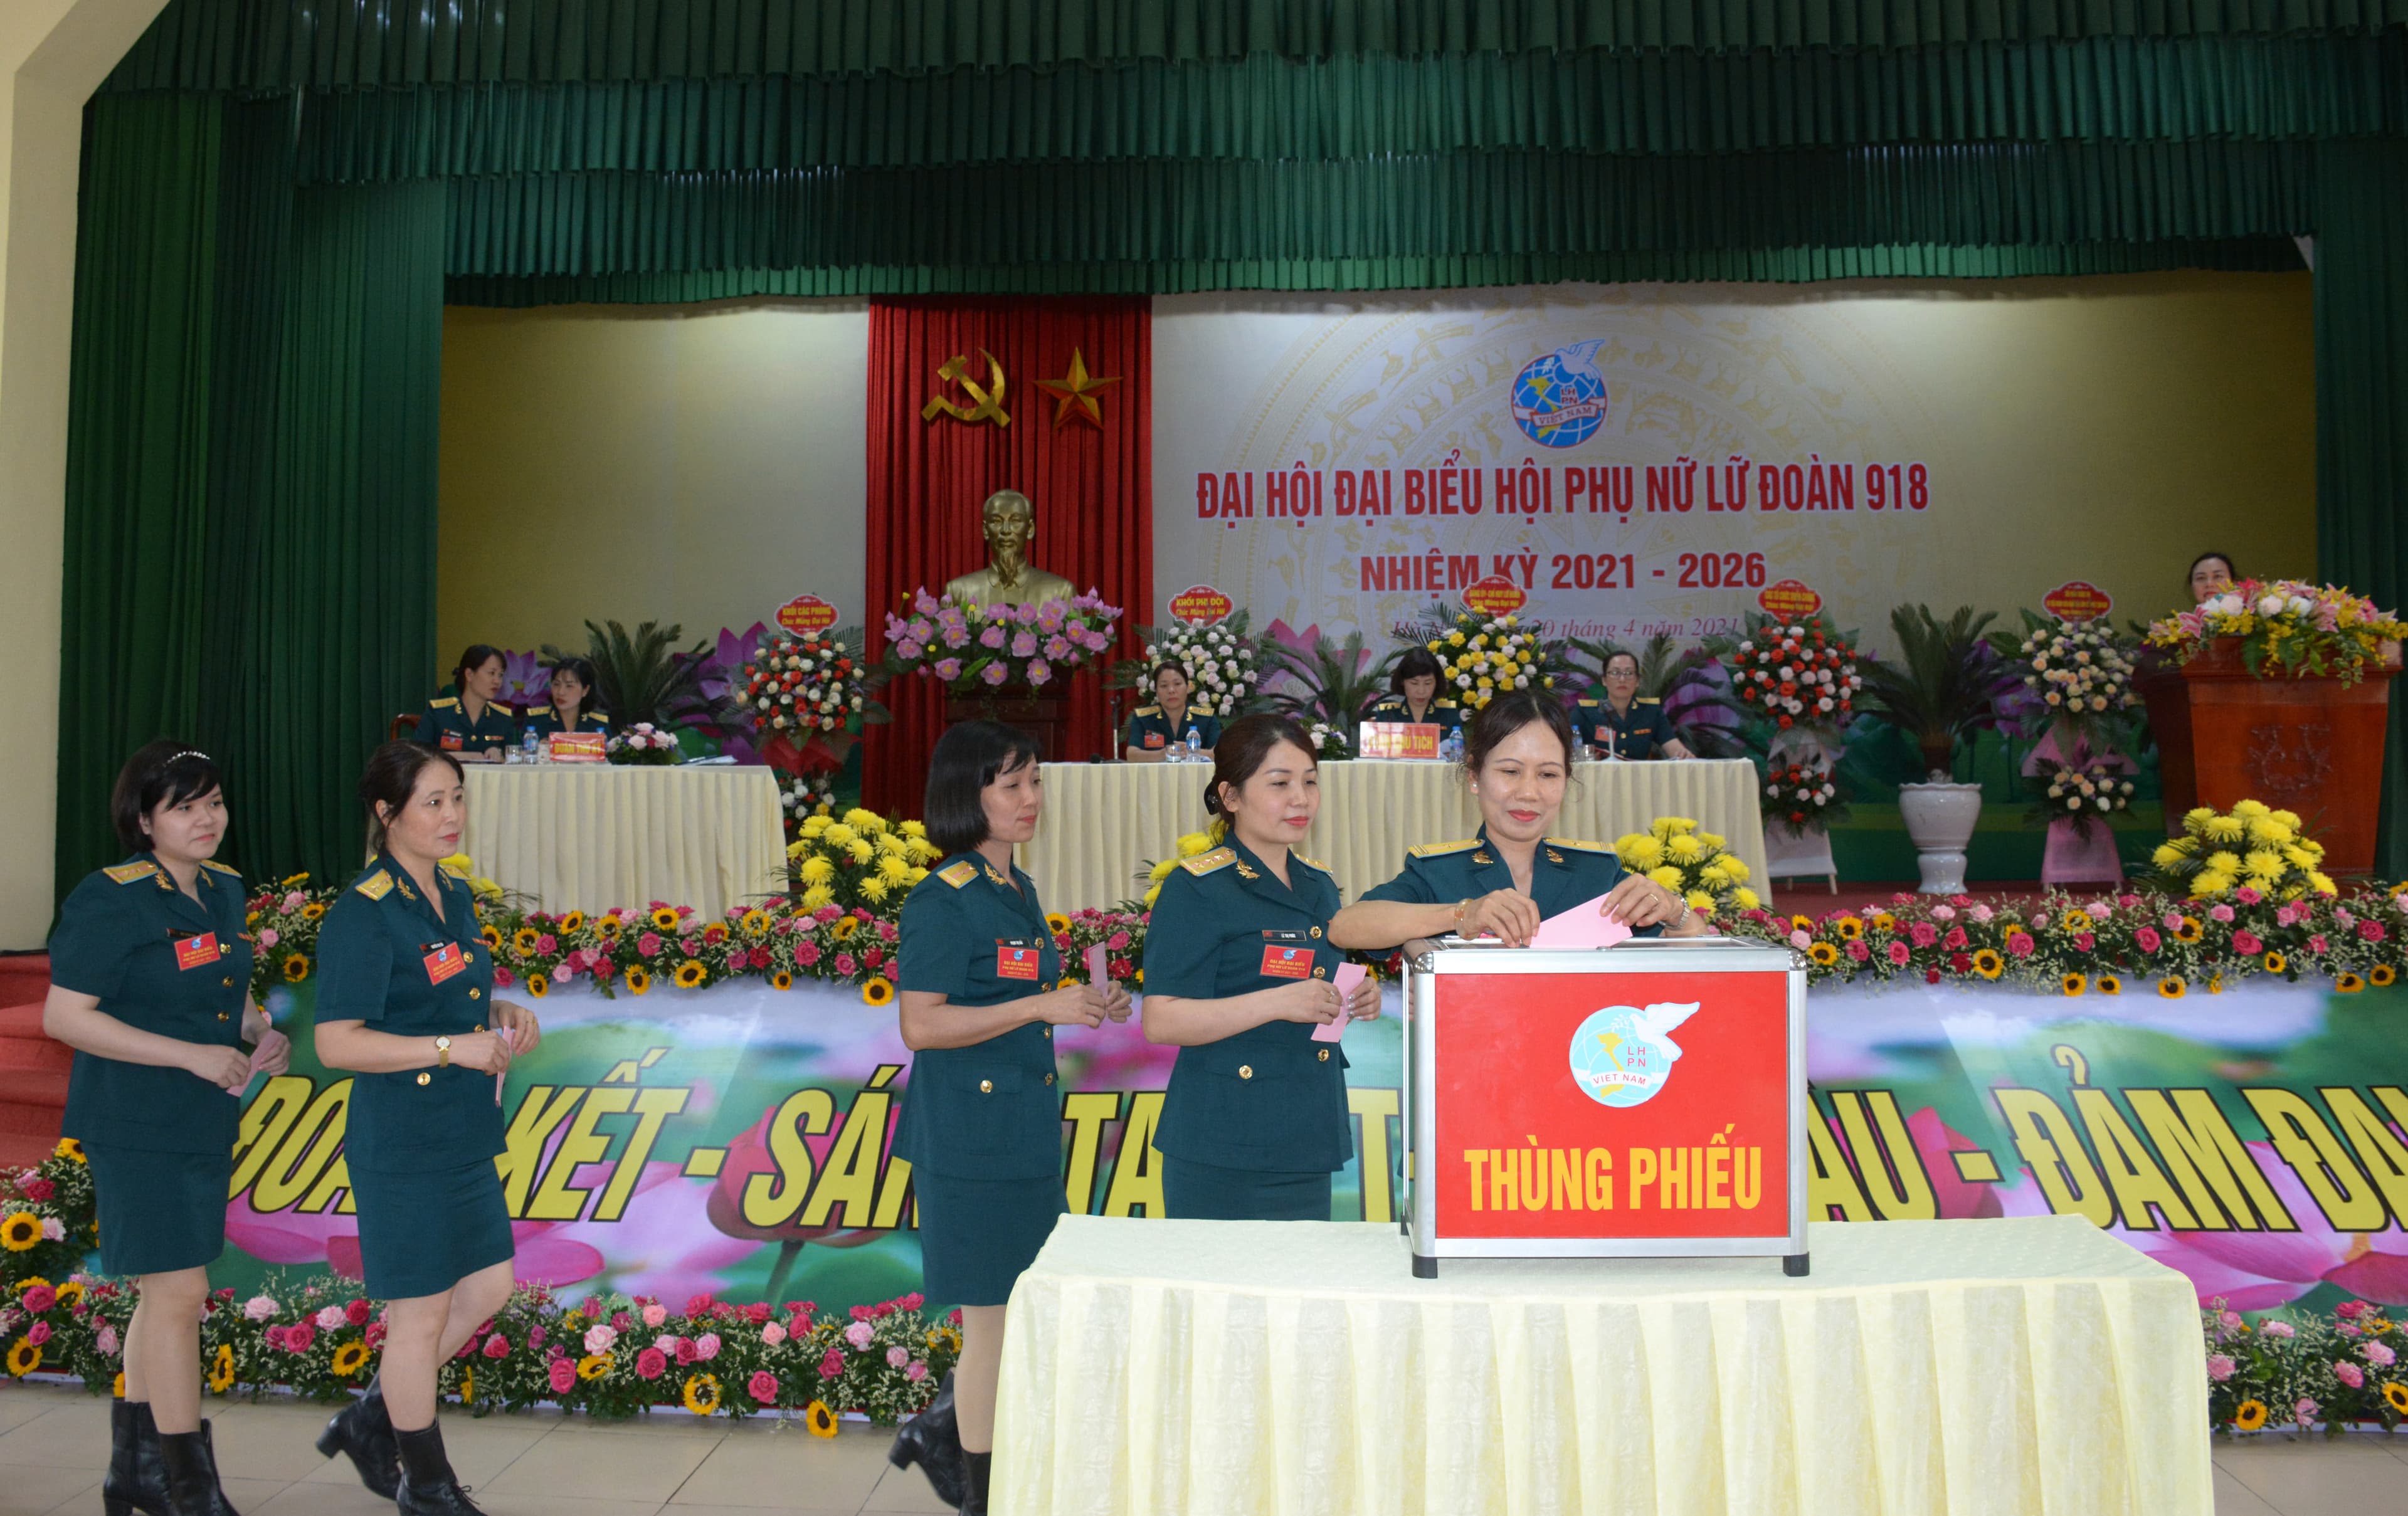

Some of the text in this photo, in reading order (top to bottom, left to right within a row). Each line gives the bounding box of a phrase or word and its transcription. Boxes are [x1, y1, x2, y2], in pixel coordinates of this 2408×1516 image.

[1196, 448, 1928, 529] ĐẠI HỘI ĐẠI BIỂU HỘI PHỤ NỮ LỮ ĐOÀN 918
[1361, 547, 1480, 599] NHIỆM
[1494, 547, 1539, 589] KỲ
[1551, 554, 1634, 589] 2021
[1678, 552, 1766, 588] 2026
[1561, 619, 1616, 641] tháng
[1623, 619, 1635, 636] 4
[1642, 621, 1684, 636] năm
[1691, 618, 1738, 636] 2021
[1414, 735, 1433, 752] TỊCH
[1627, 1046, 1645, 1055] LH
[1627, 1058, 1645, 1067] PN
[1593, 1074, 1646, 1085] VIET NAM
[494, 1046, 695, 1222] KẾT
[679, 1146, 731, 1177] -
[1989, 1043, 2301, 1232] ĐẢM
[2236, 1085, 2408, 1233] ĐA
[1464, 1123, 1761, 1211] THÙNG PHIẾU
